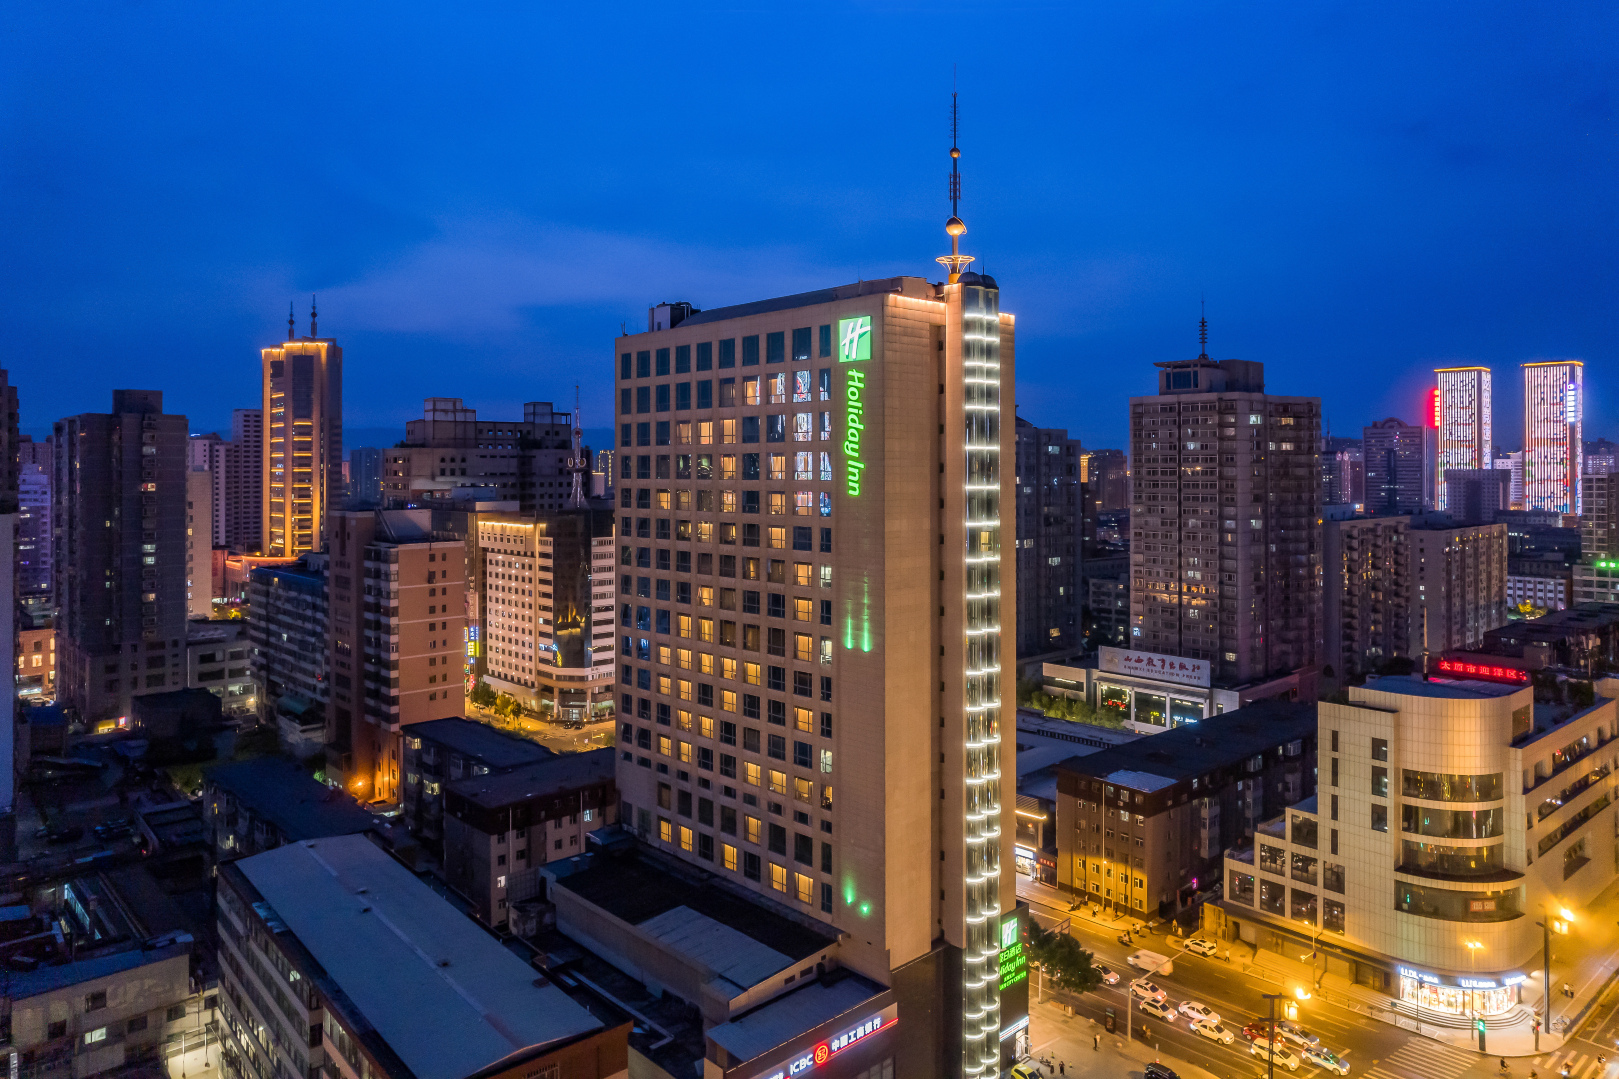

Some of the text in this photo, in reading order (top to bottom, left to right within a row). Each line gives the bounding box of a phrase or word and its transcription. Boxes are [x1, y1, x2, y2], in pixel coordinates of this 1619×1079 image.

[844, 369, 865, 496] Holiday Inn
[789, 1053, 813, 1075] ICBC
